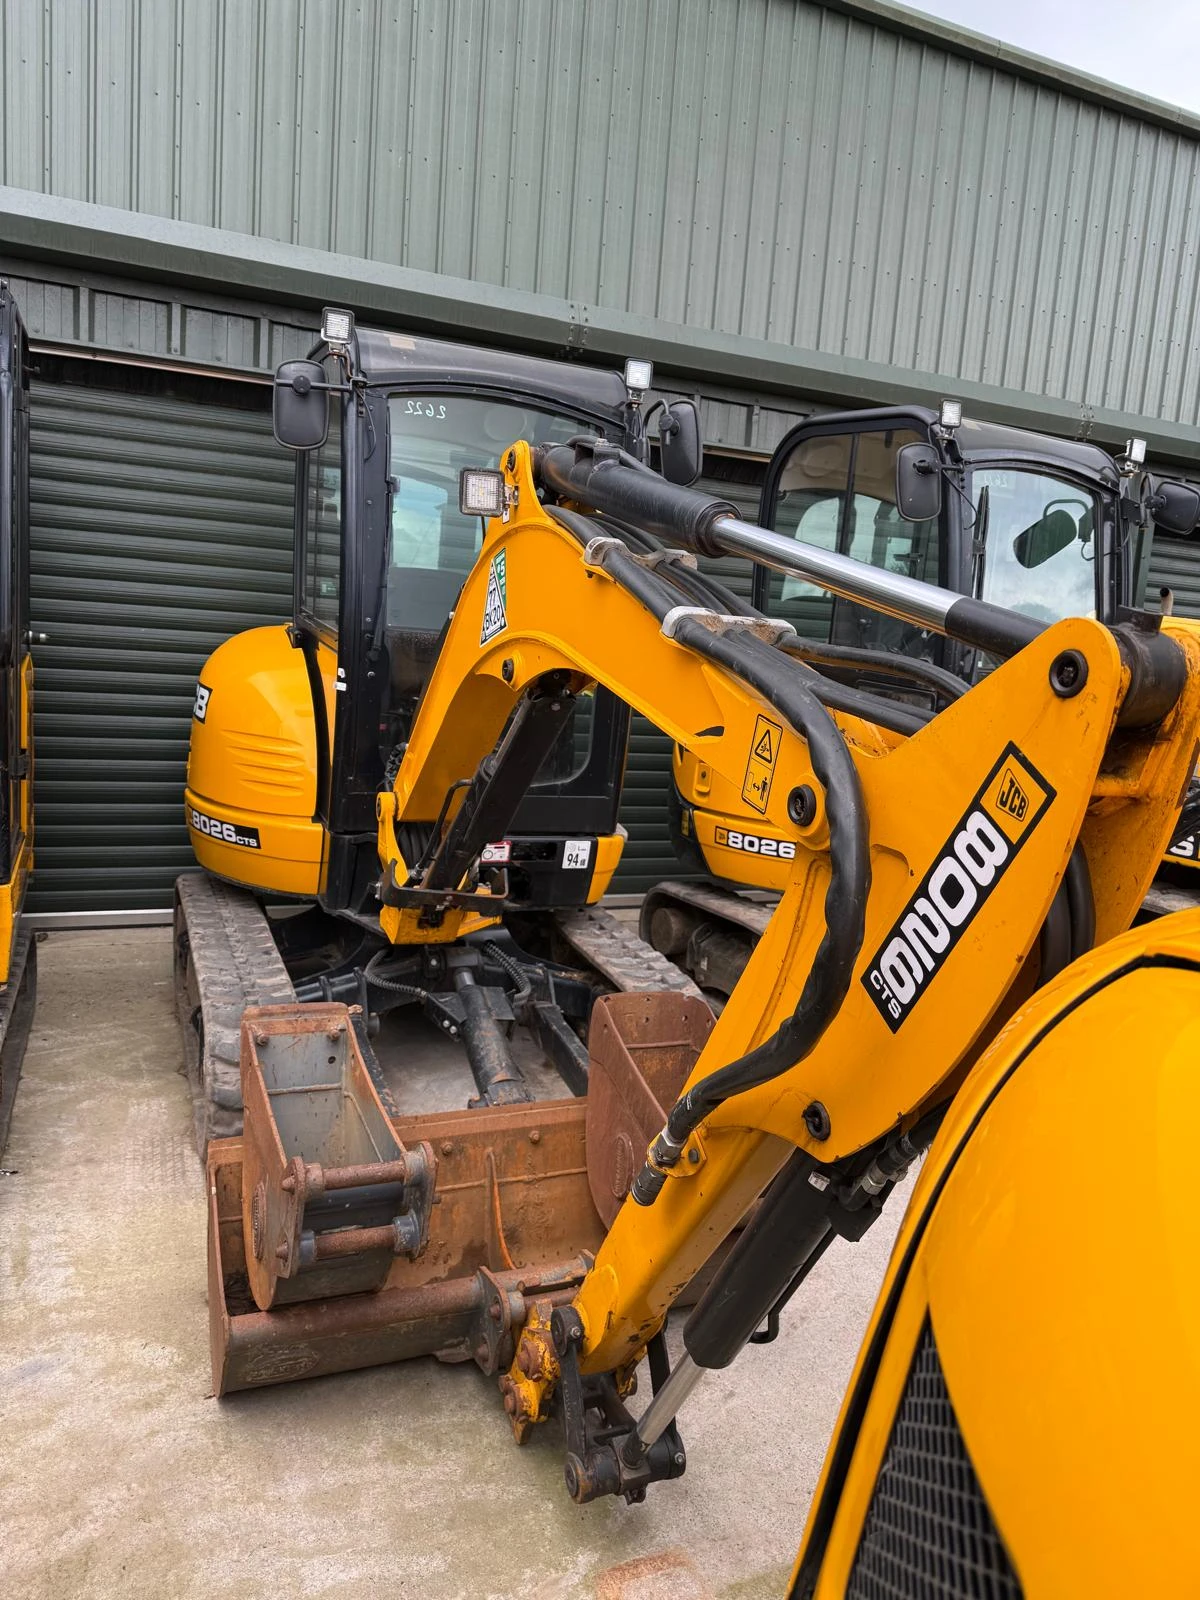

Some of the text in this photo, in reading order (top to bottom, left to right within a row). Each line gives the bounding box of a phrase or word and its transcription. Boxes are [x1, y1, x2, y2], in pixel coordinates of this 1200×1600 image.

[1000, 776, 1027, 819] JCB
[192, 811, 258, 848] 8026 CTS
[728, 831, 796, 859] 8026
[567, 853, 579, 867] 94
[870, 811, 1009, 1020] 8026 CTS
